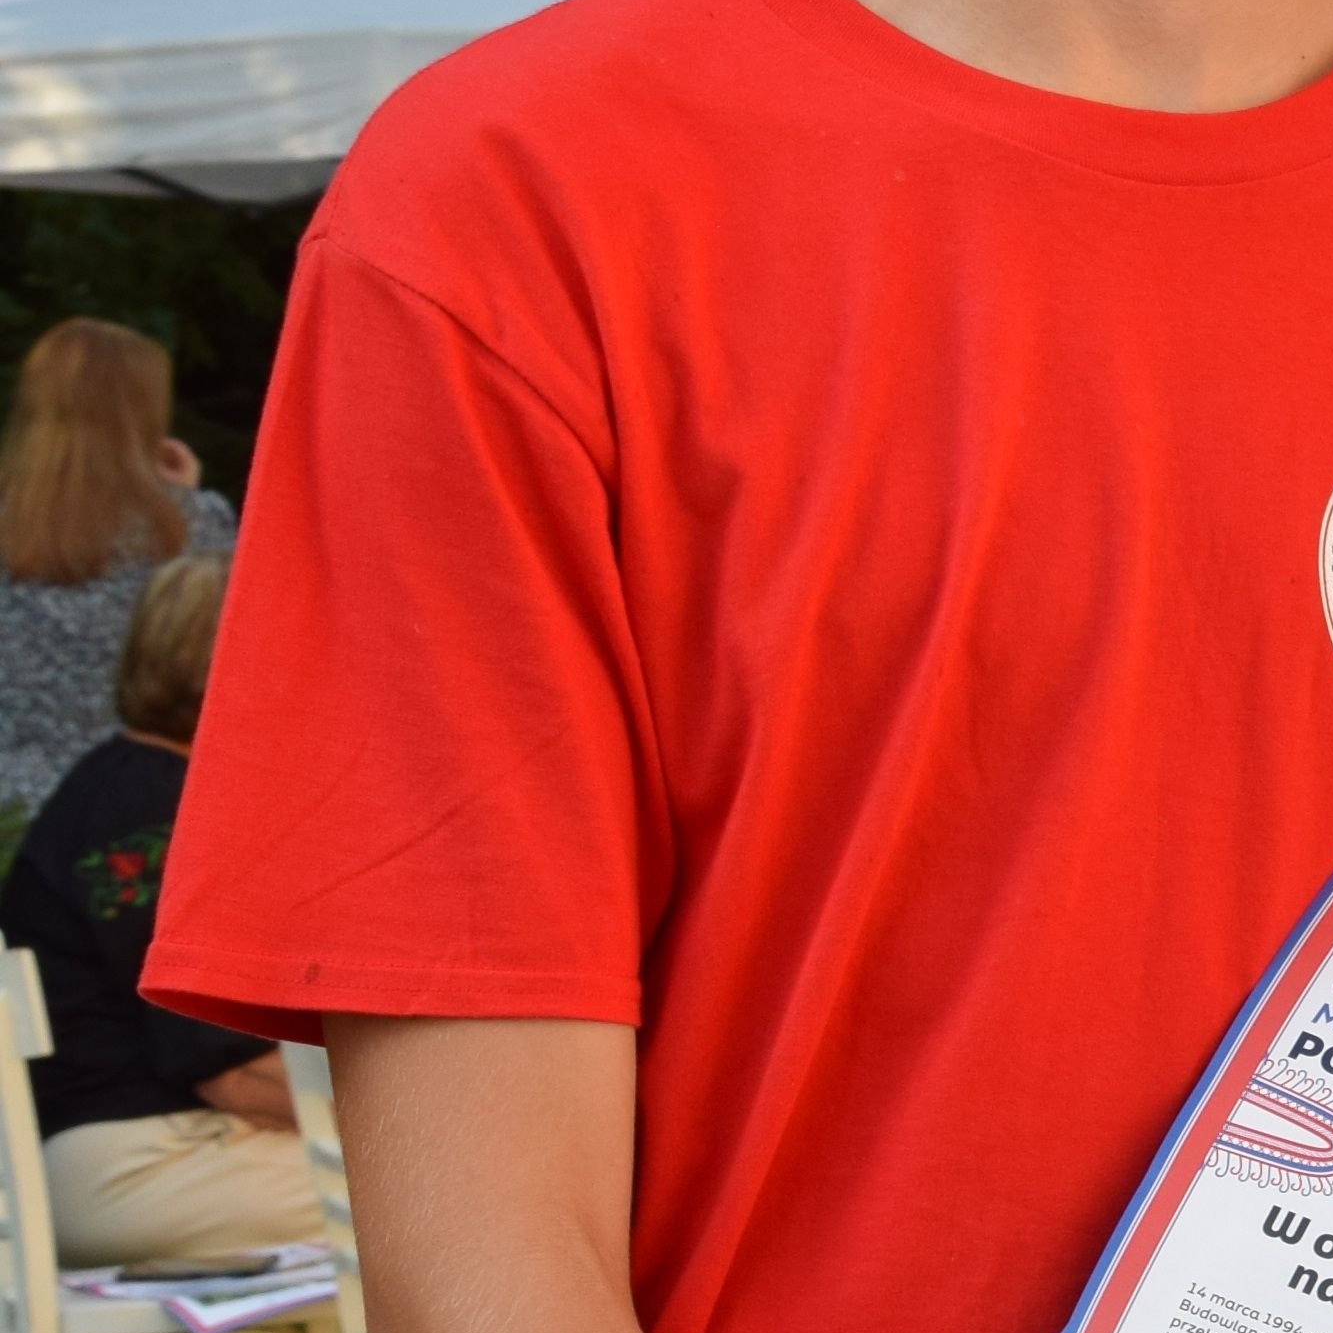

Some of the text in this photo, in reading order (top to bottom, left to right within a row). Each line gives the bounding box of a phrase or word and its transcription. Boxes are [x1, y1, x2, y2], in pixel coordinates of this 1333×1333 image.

[1262, 1206, 1311, 1245] W
[1187, 1282, 1206, 1298] 14
[1209, 1294, 1260, 1321] marca
